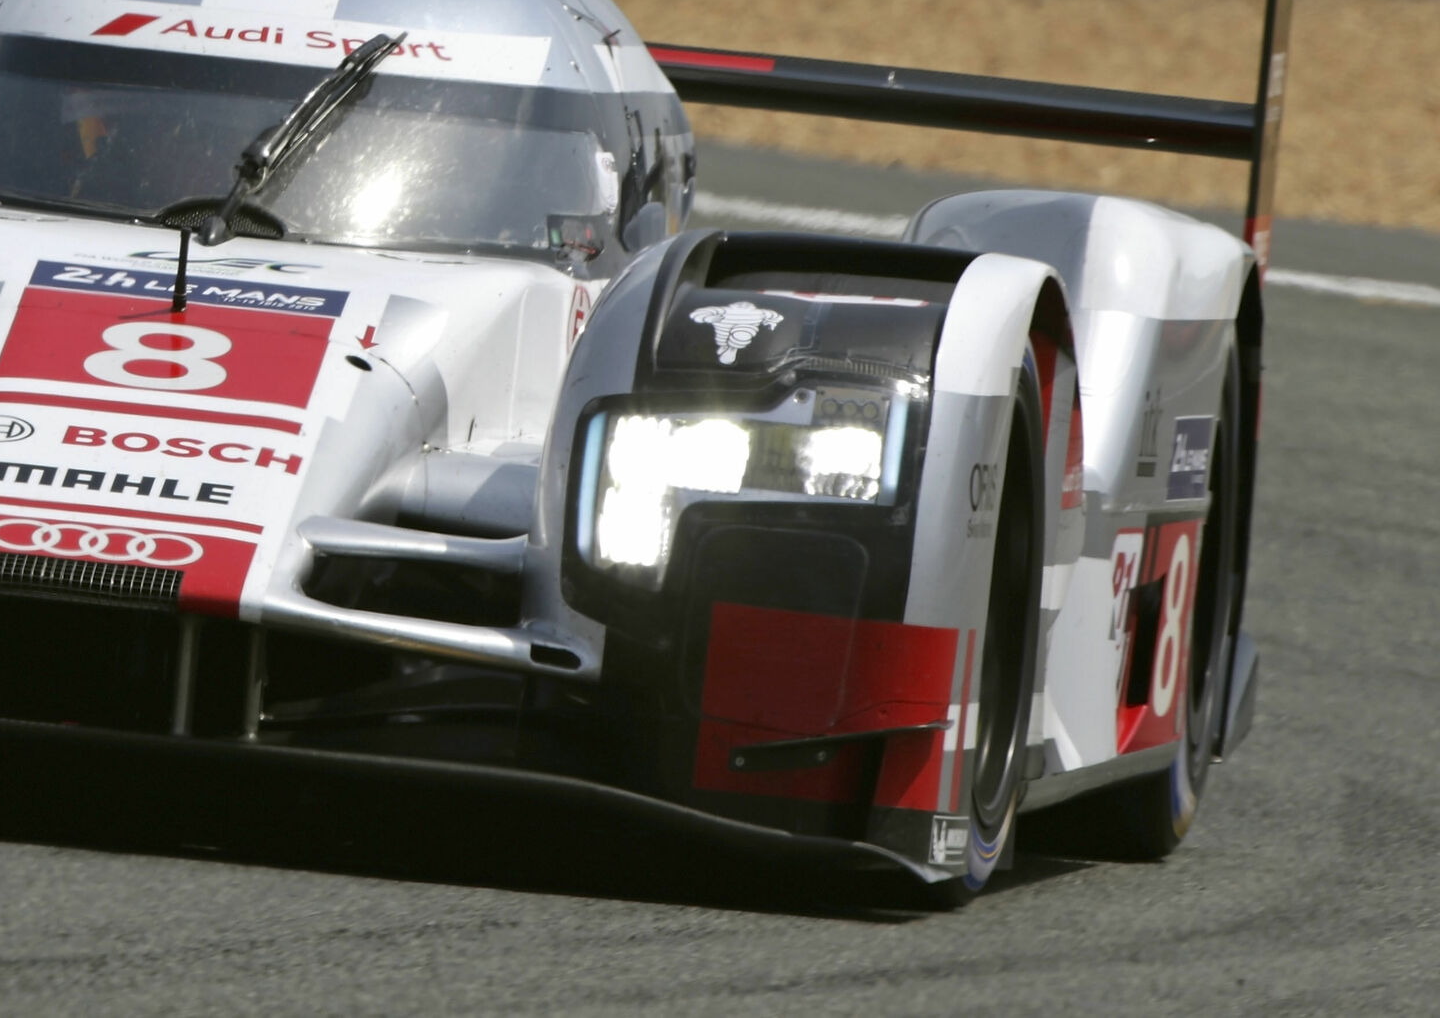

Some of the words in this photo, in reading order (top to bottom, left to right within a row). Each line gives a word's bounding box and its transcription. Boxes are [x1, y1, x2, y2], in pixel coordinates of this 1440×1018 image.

[160, 18, 284, 45] Audi
[143, 280, 198, 295] LE
[202, 285, 326, 308] MANS
[82, 320, 233, 391] 8
[61, 424, 304, 475] BOSCH
[1151, 532, 1190, 718] 8
